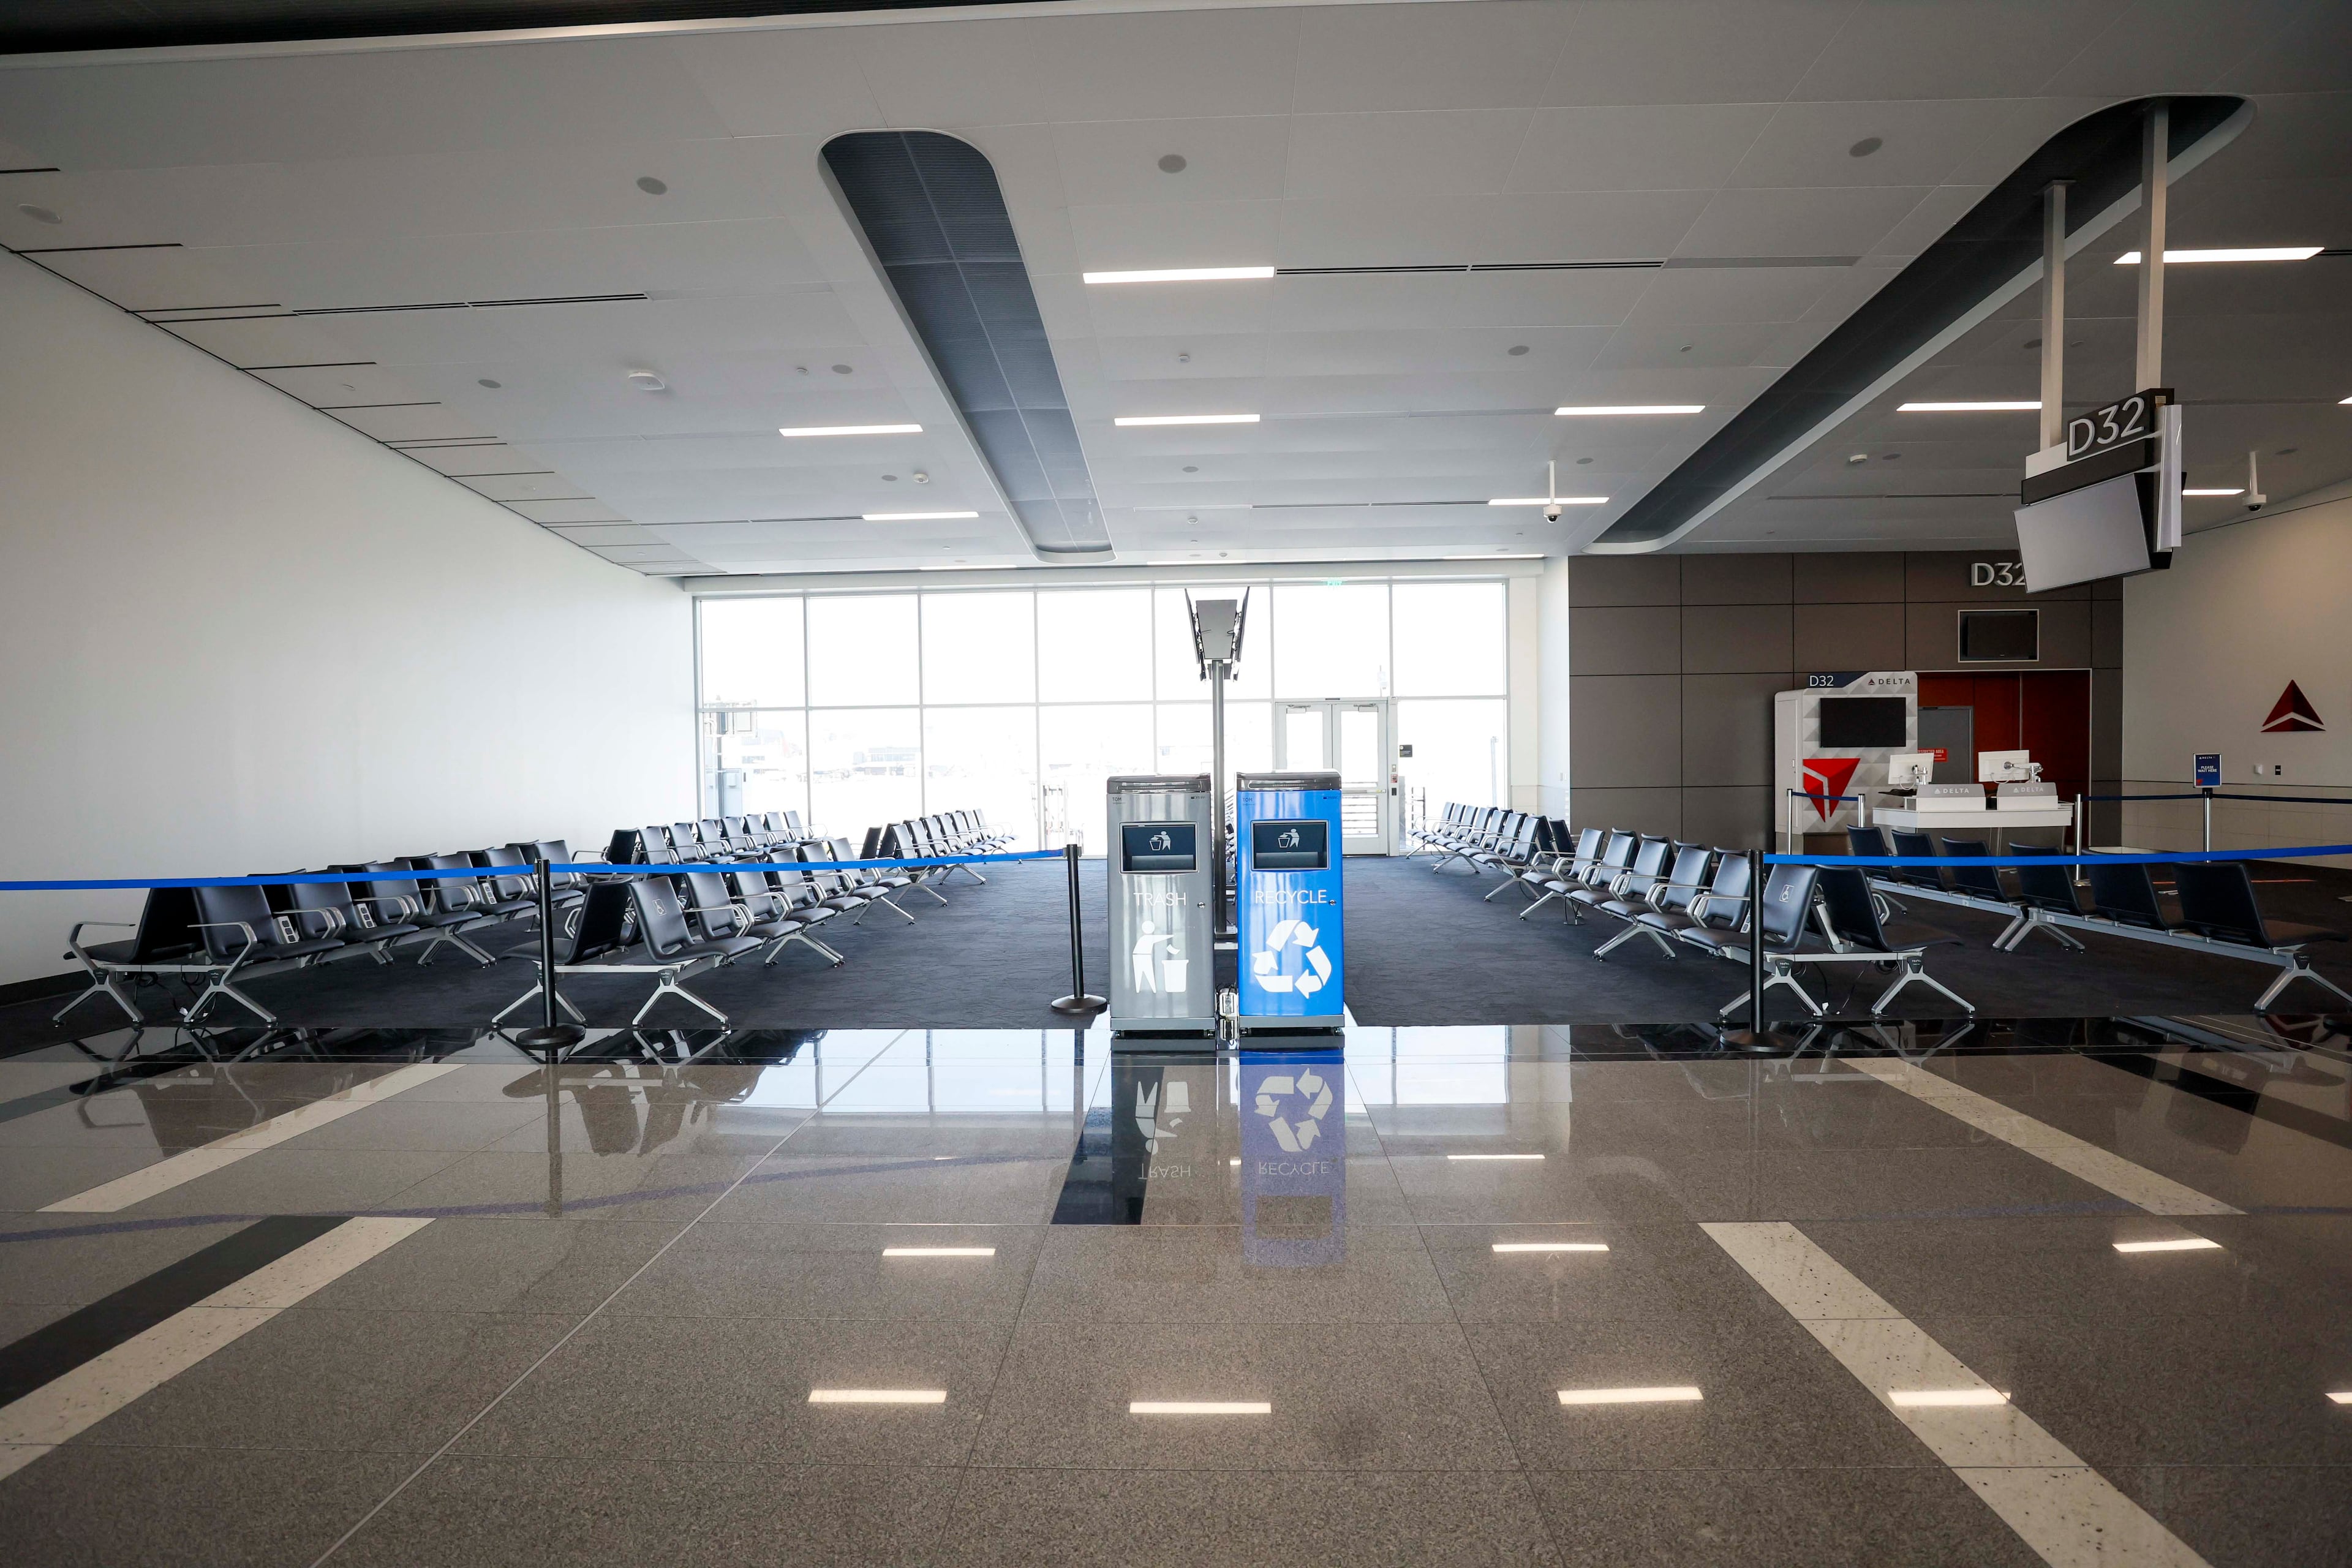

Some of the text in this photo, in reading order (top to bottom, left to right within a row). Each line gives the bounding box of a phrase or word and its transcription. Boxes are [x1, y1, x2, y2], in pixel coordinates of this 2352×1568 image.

[2069, 397, 2144, 456] D32
[1809, 676, 1834, 687] D32
[1134, 892, 1186, 907] TRASH
[1255, 890, 1327, 904] RECYCLE
